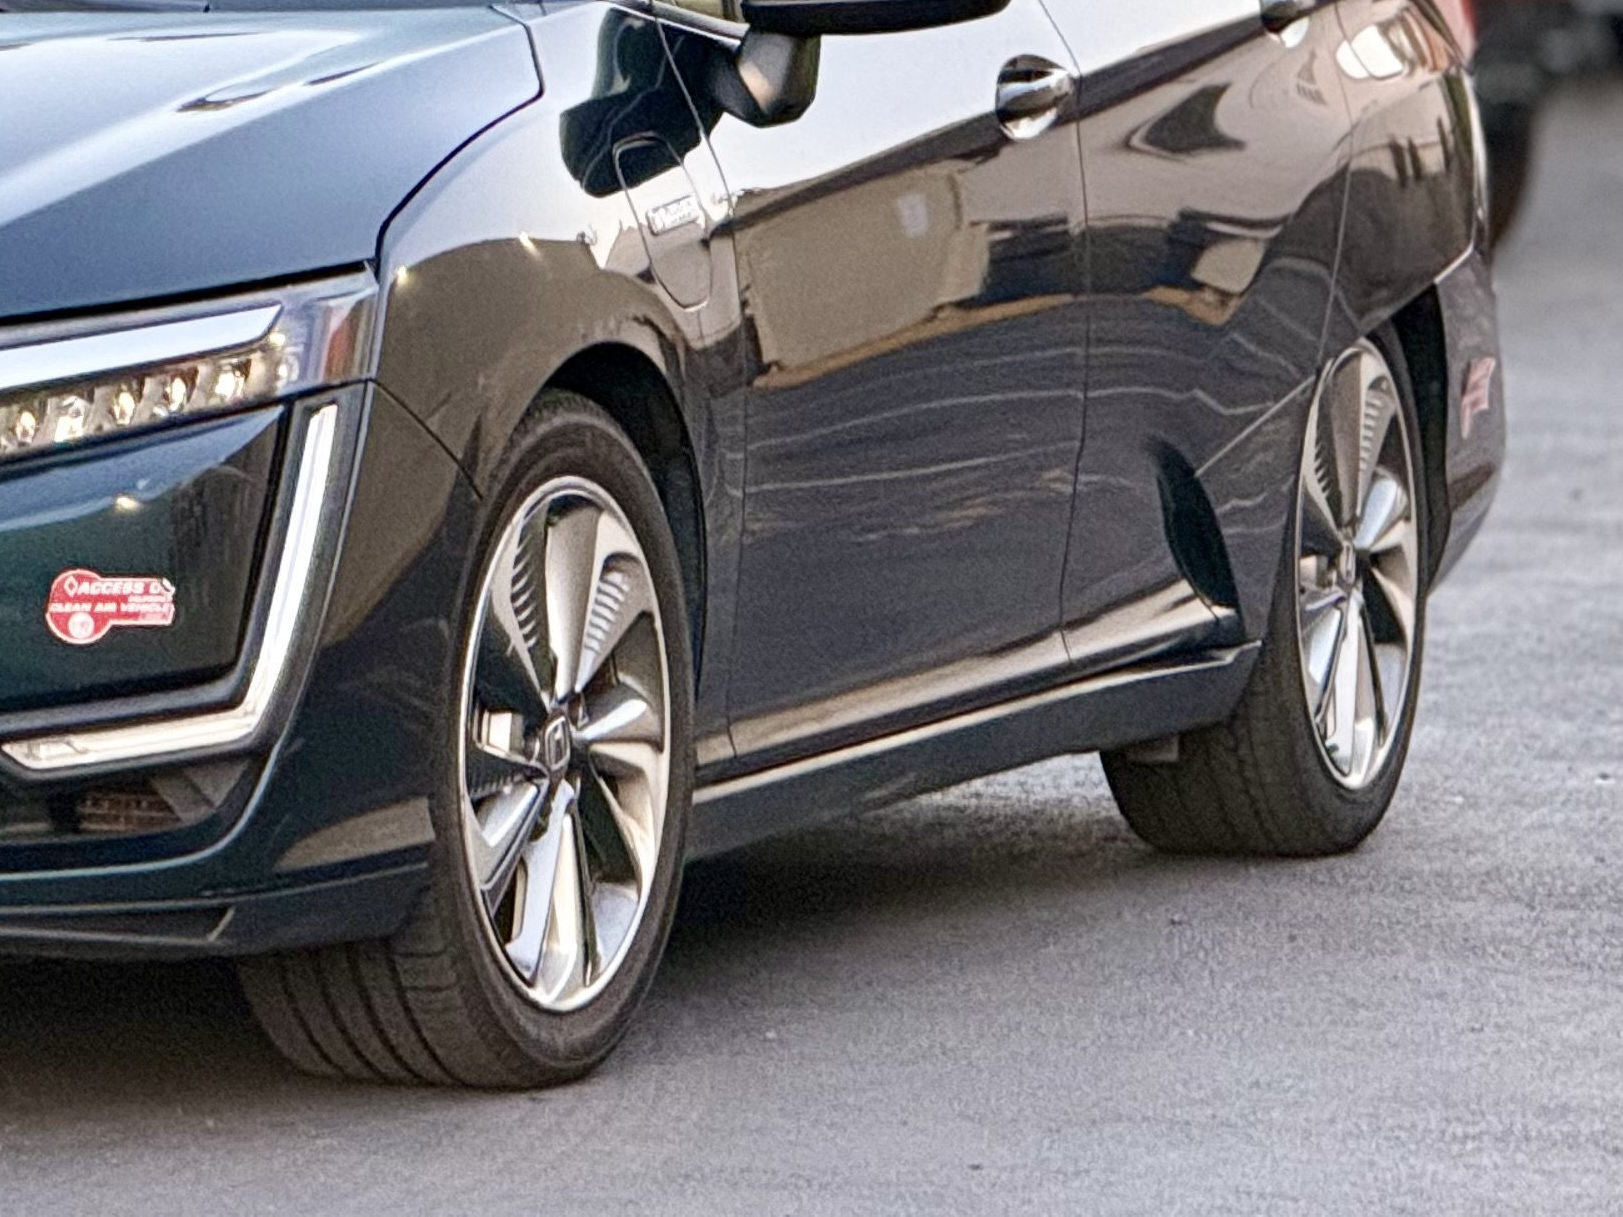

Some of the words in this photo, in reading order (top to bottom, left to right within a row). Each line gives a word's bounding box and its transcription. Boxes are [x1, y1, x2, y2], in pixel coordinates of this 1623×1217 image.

[76, 581, 145, 595] ACCESS
[94, 602, 118, 613] AIR
[120, 602, 170, 613] VEHICLE
